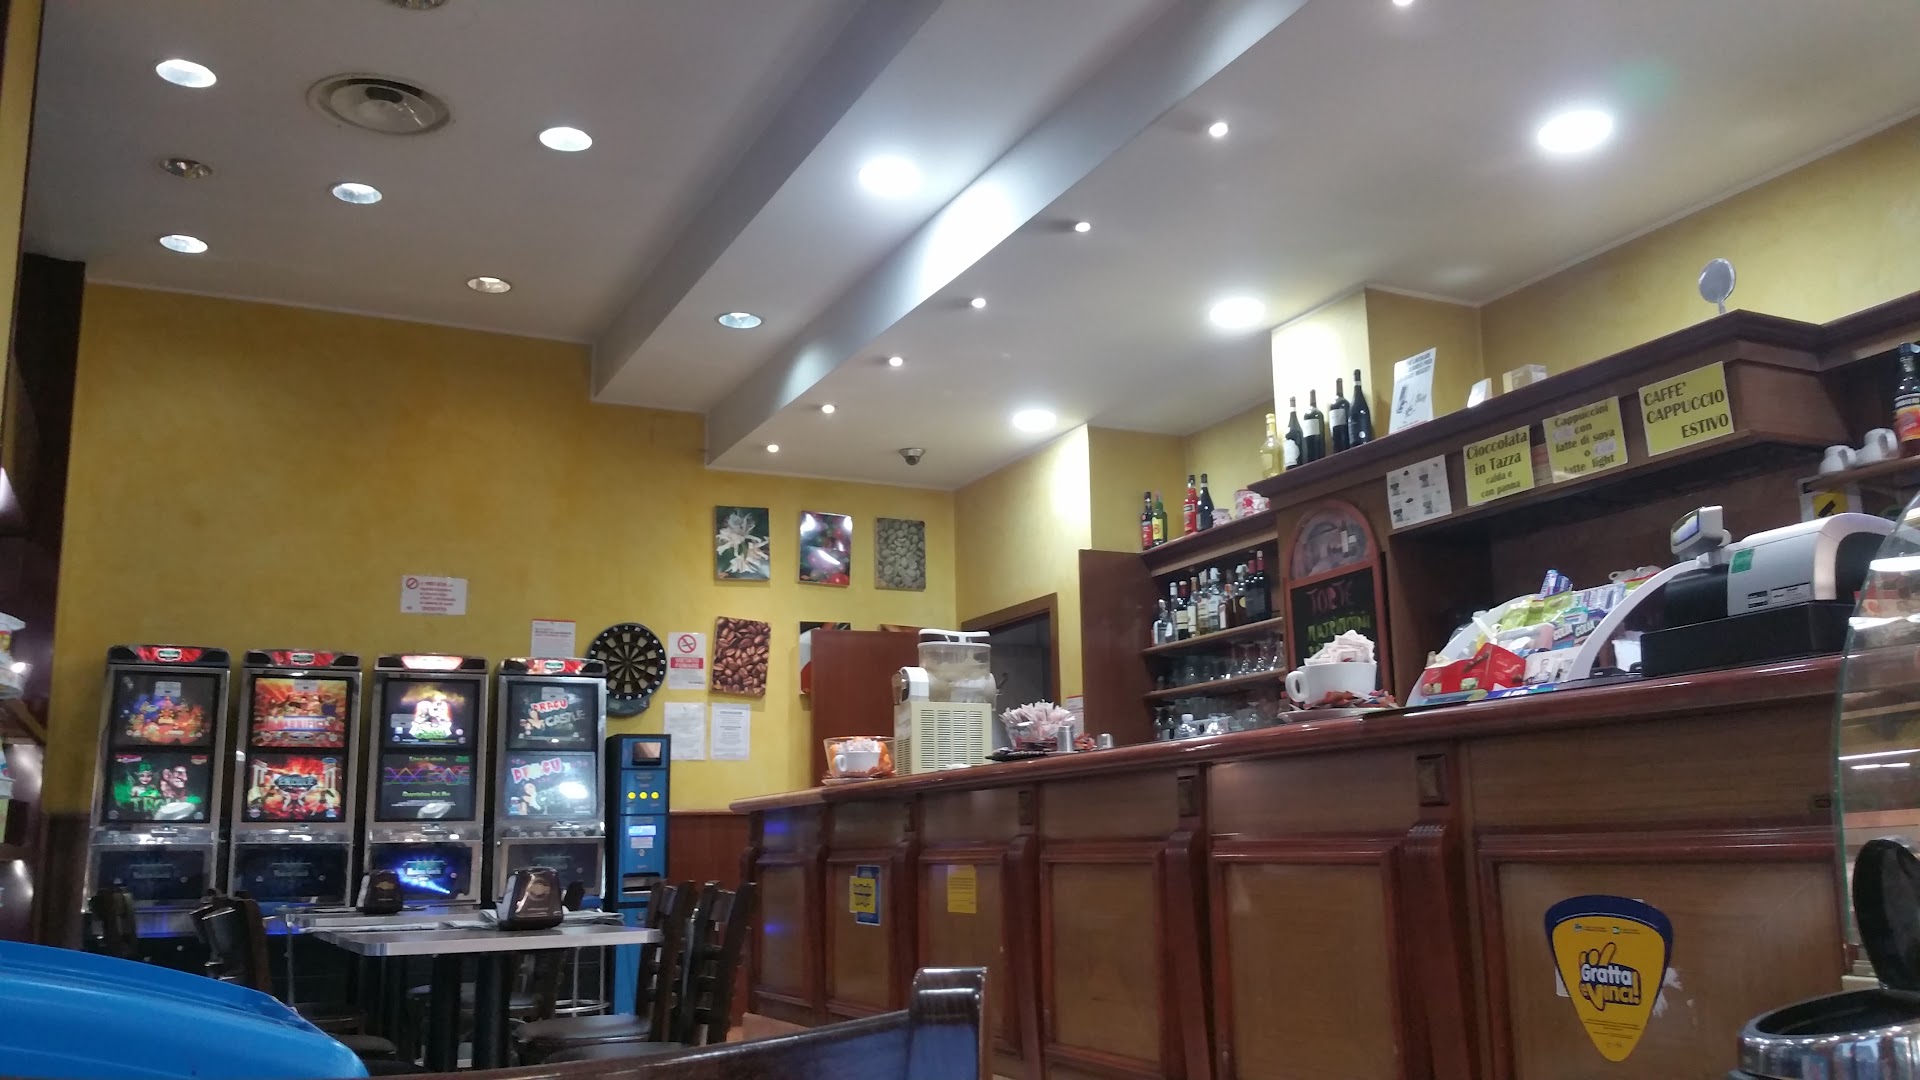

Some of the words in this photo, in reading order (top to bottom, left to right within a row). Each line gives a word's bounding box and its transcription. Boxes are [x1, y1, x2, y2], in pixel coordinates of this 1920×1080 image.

[1643, 382, 1686, 406] CAFFE'
[1555, 403, 1609, 427] Cappuccini
[1646, 389, 1725, 424] CAPPUCCIO
[1574, 423, 1592, 435] con
[1580, 435, 1590, 446] di
[1592, 429, 1616, 442] soya
[1681, 413, 1729, 438] ESTIVO
[1466, 432, 1528, 460] Cioccolata
[1475, 463, 1486, 476] in
[1490, 452, 1522, 471] Tazza
[1592, 454, 1615, 468] light
[1581, 963, 1632, 986] Gratta
